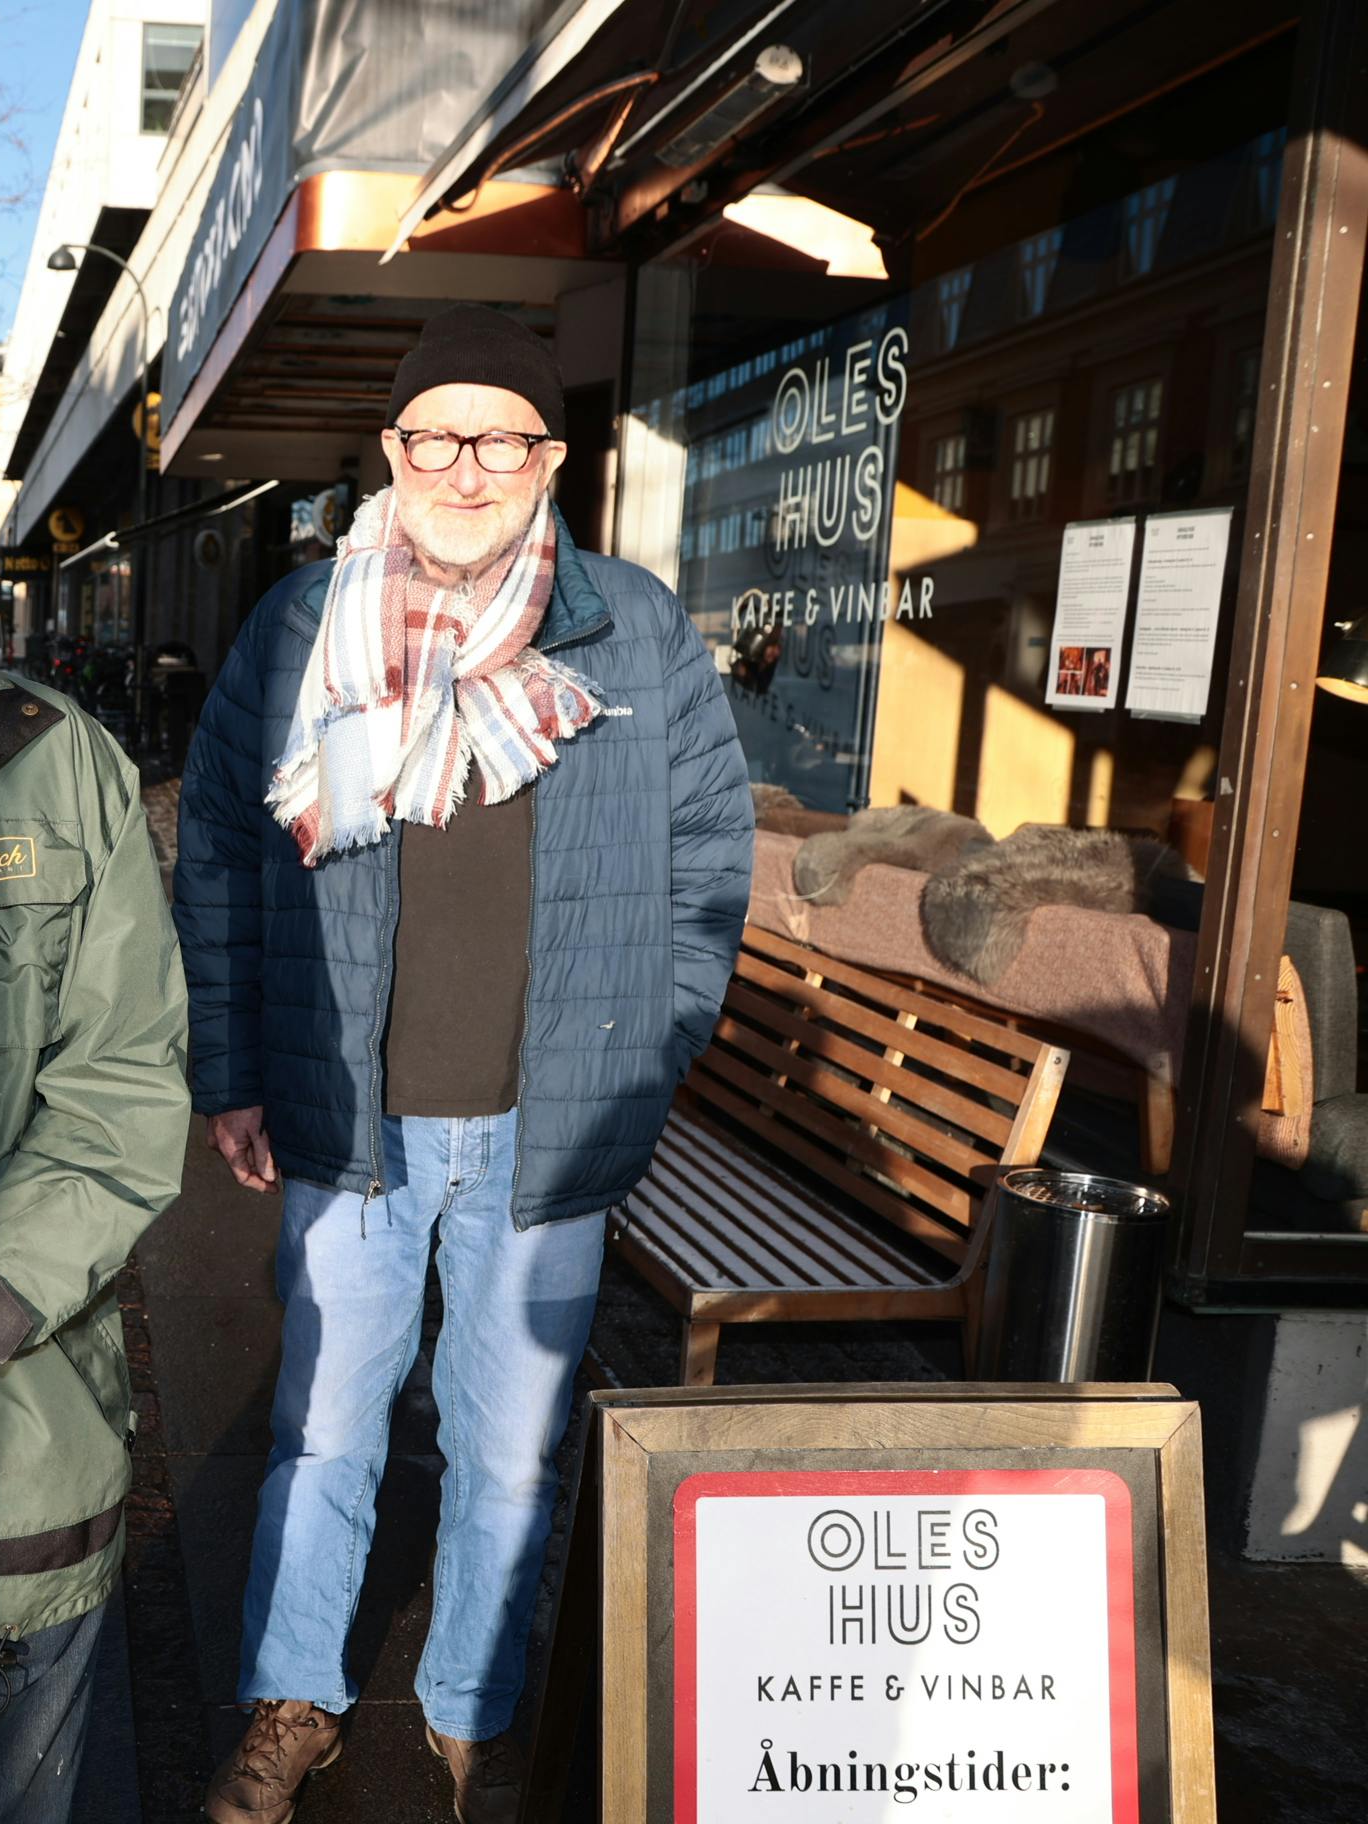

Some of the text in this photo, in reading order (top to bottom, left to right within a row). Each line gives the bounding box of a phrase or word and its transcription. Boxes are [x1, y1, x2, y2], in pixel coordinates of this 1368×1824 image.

[773, 327, 909, 454] OLES
[777, 445, 885, 552] HUS
[731, 577, 934, 630] KAFFE & VINBAR
[807, 1508, 999, 1571] OLES
[829, 1583, 980, 1645] HUS
[757, 1674, 1056, 1702] KAFFE & VINBAR
[747, 1738, 1070, 1804] Åbningstider:
